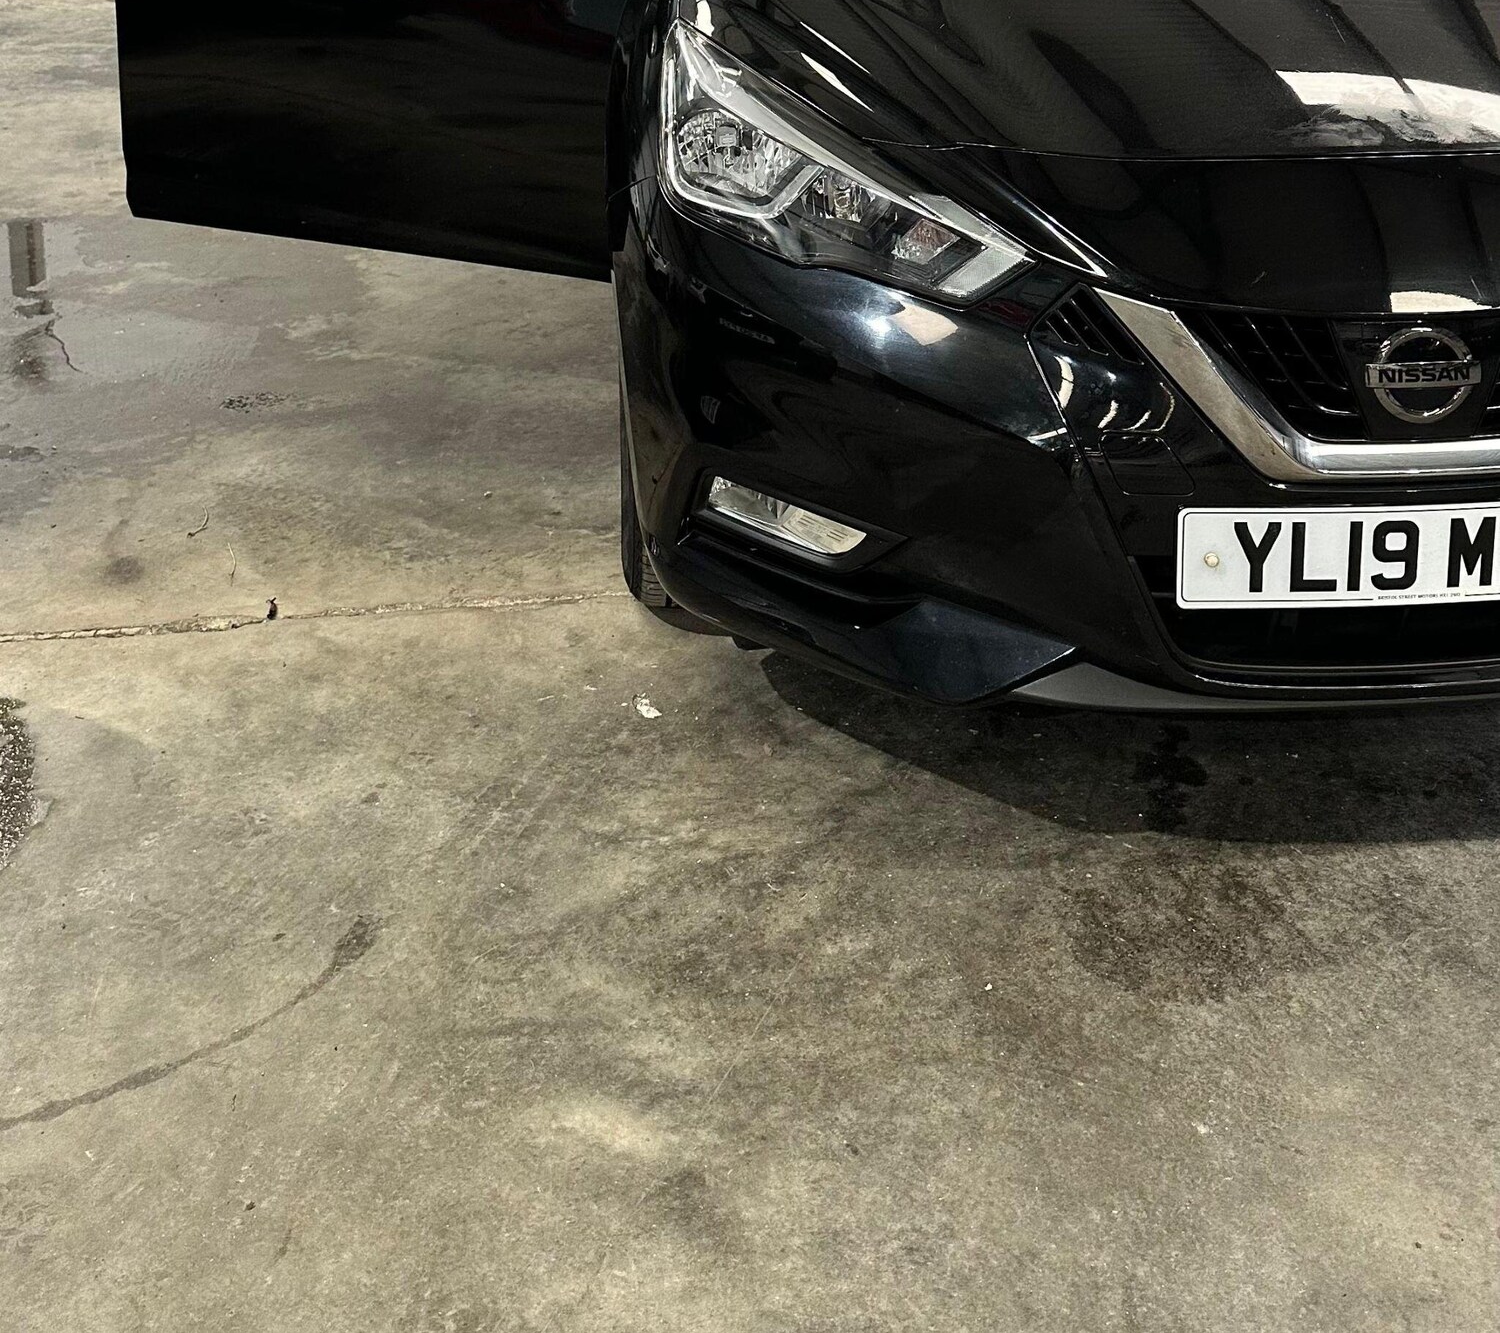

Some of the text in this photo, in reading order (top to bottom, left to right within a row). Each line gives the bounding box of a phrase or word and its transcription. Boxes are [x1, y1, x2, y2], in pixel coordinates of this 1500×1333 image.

[1378, 367, 1471, 384] NISSAN
[1233, 516, 1497, 593] YL19 M
